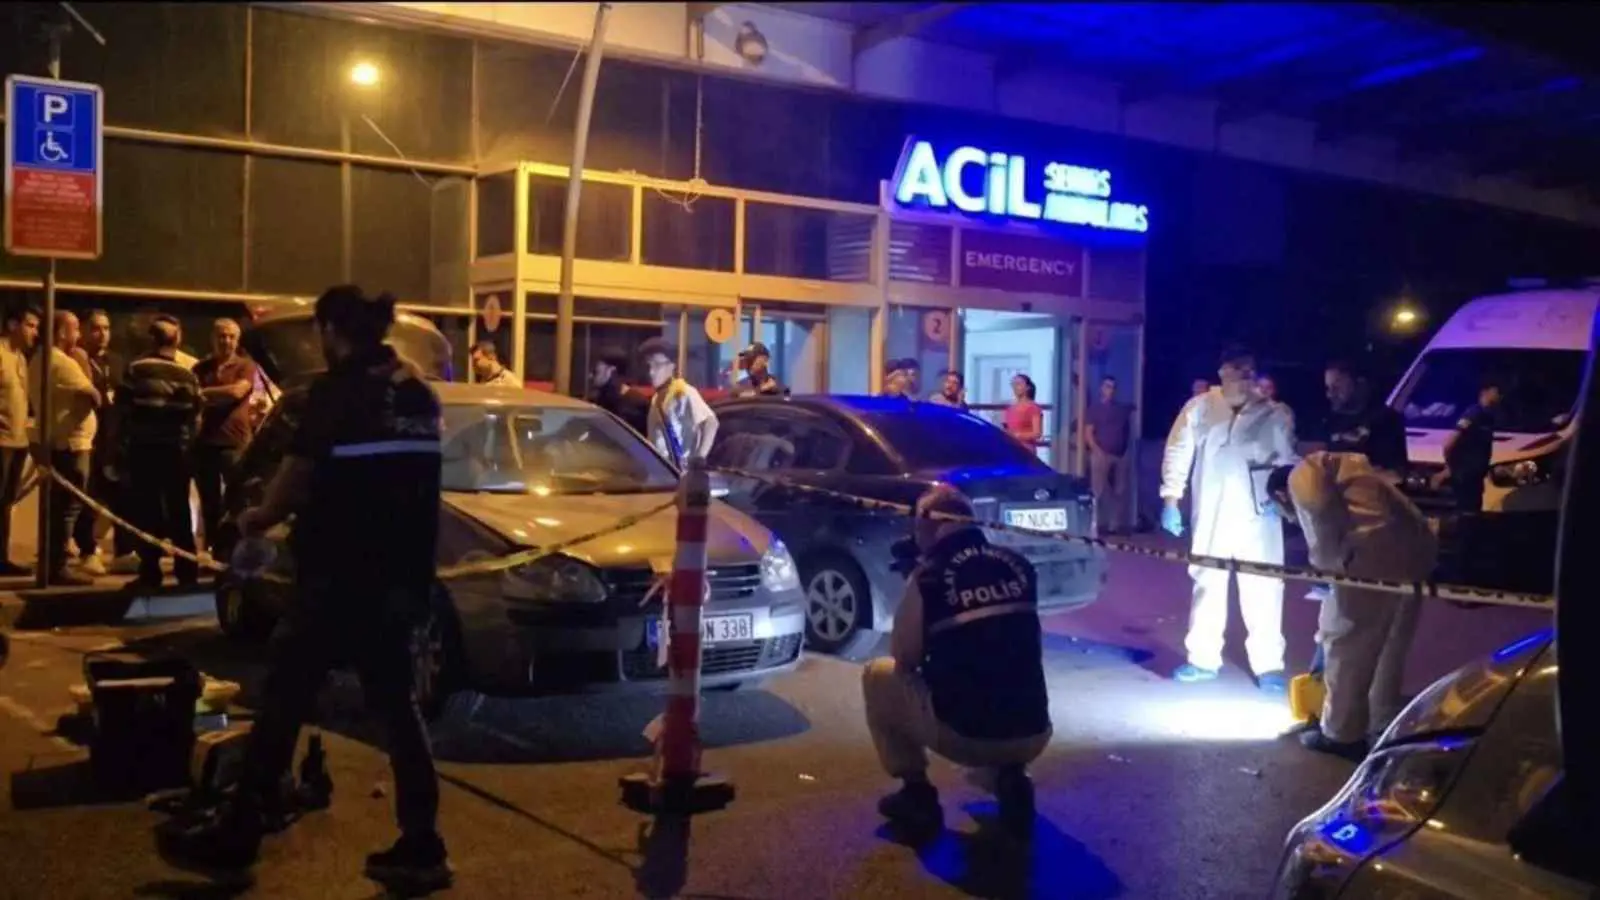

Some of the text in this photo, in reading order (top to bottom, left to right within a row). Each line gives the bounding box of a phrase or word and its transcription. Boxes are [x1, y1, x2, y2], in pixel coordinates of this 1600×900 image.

[44, 95, 69, 123] P
[965, 251, 1076, 276] EMERGENCY
[715, 315, 724, 335] 1
[932, 317, 943, 336] 2
